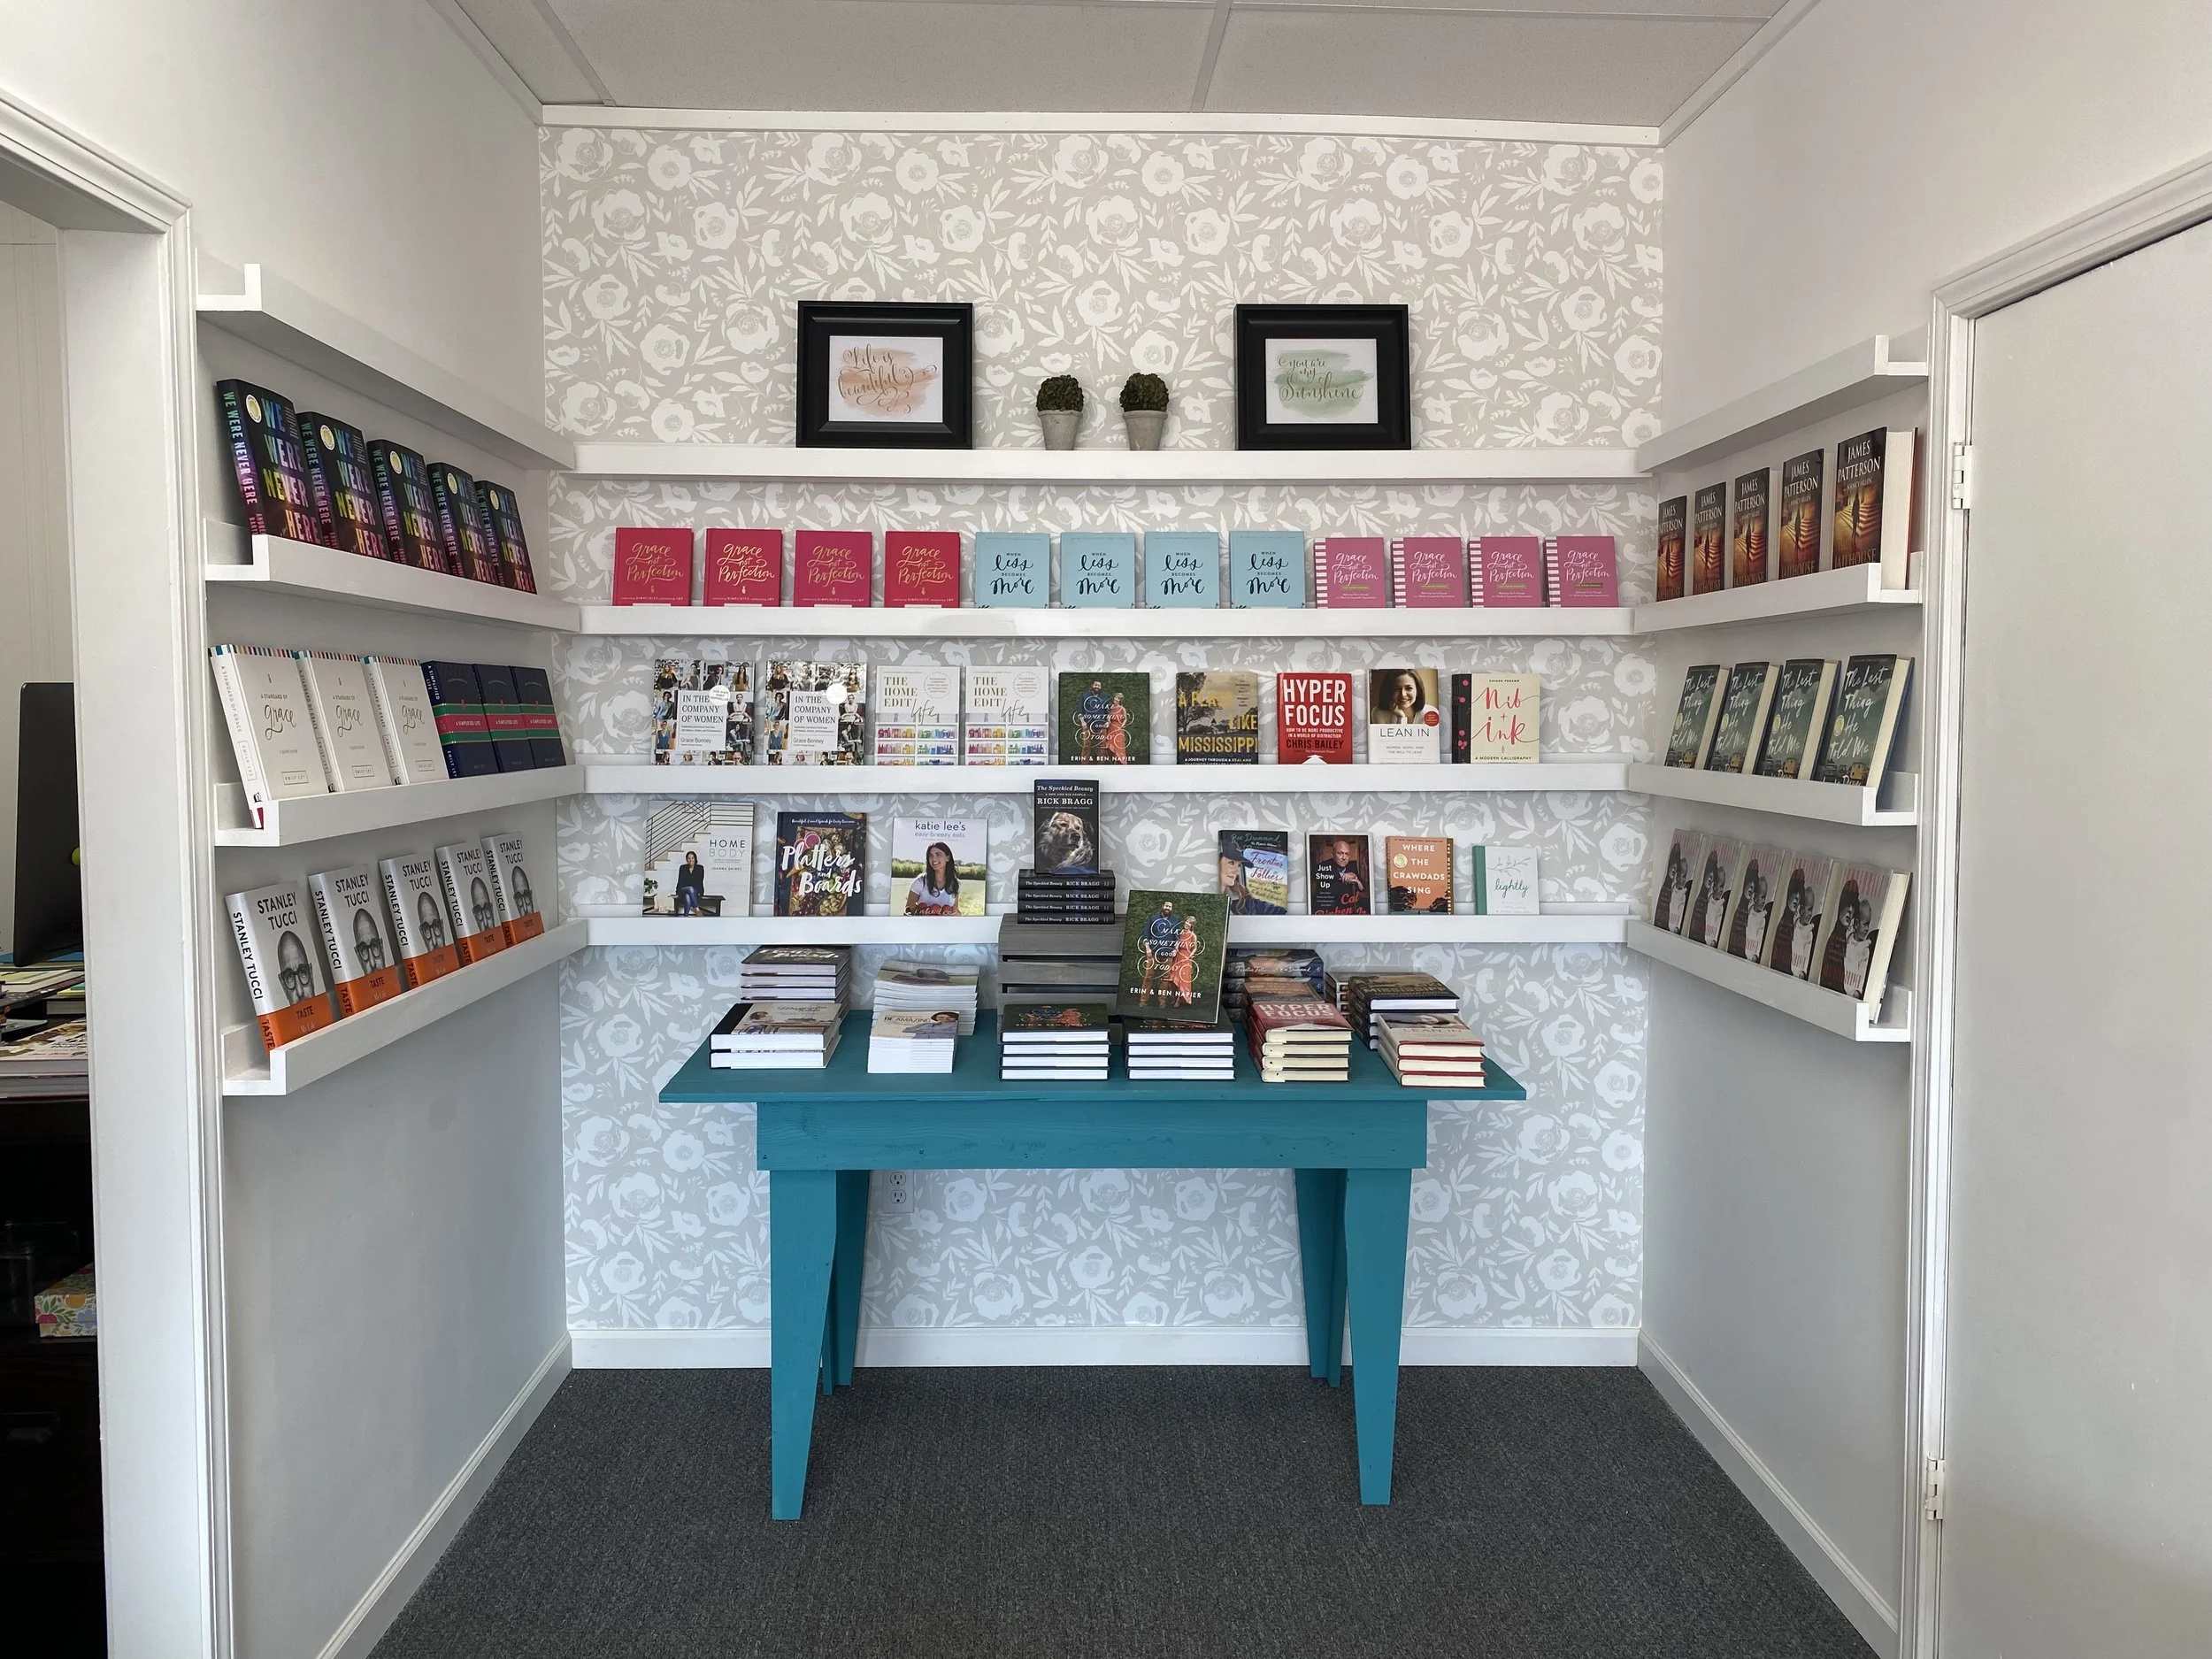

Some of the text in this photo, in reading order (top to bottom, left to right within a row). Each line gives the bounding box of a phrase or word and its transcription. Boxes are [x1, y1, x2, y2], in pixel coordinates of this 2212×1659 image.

[842, 343, 894, 374] Life is
[1311, 357, 1328, 368] are
[1300, 367, 1316, 380] my
[261, 398, 286, 432] WE
[223, 391, 258, 505] WE WERE NEVER HERE
[334, 427, 354, 458] WE
[1847, 440, 1870, 464] JAMES
[264, 434, 304, 472] WERE
[336, 460, 371, 494] WERE
[1791, 460, 1810, 481] JAMES
[1837, 457, 1881, 483] PATTERSON
[262, 468, 309, 508] NEVER
[1741, 478, 1758, 497] JAMES
[1784, 476, 1818, 499] PATTERSON
[335, 490, 375, 526] NEVER
[285, 510, 321, 544] HERE
[355, 527, 387, 559] HERE
[992, 554, 1033, 572] less
[1078, 554, 1119, 572] less
[1161, 554, 1203, 572] less
[1247, 554, 1289, 571] less
[884, 676, 908, 686] THE
[973, 676, 998, 686] THE
[1845, 665, 1889, 690] The Last
[884, 687, 918, 696] HOME
[973, 687, 1008, 696] HOME
[1283, 680, 1347, 703] HYPER
[681, 704, 720, 713] COMPANY
[884, 698, 913, 707] EDIT
[973, 698, 1002, 707] EDIT
[1844, 690, 1874, 719] Thing
[264, 704, 297, 741] grace
[694, 715, 724, 724] WOMEN
[1228, 715, 1257, 731] LIKE
[1285, 704, 1345, 726] FOCUS
[1845, 715, 1859, 734] He
[1380, 727, 1430, 738] LEAN IN
[1179, 736, 1258, 753] MISSISSIPPI
[1286, 740, 1344, 749] CHRIS BAILEY
[1830, 737, 1854, 759] Told
[915, 819, 966, 831] katie lee's
[499, 840, 524, 853] STANLEY
[710, 840, 746, 849] HOME
[710, 849, 746, 857] BODY
[505, 853, 524, 864] TUCCI
[781, 842, 855, 871] Platters
[402, 860, 432, 877] STANLEY
[1250, 867, 1284, 881] Follies
[335, 874, 370, 894] STANLEY
[409, 875, 432, 891] TUCCI
[800, 870, 863, 897] Boards
[1494, 879, 1530, 898] lightly
[257, 892, 298, 915] STANLEY
[344, 890, 370, 908] TUCCI
[1341, 892, 1359, 904] Cal
[267, 910, 298, 931] TUCCI
[315, 890, 342, 970] STANLEY TUCCI
[233, 911, 264, 1000] STANLEY TUCCI
[340, 987, 353, 1013] TASTE
[1175, 990, 1202, 999] NAPIER
[296, 1005, 314, 1020] TASTE
[262, 1019, 276, 1048] TASTE
